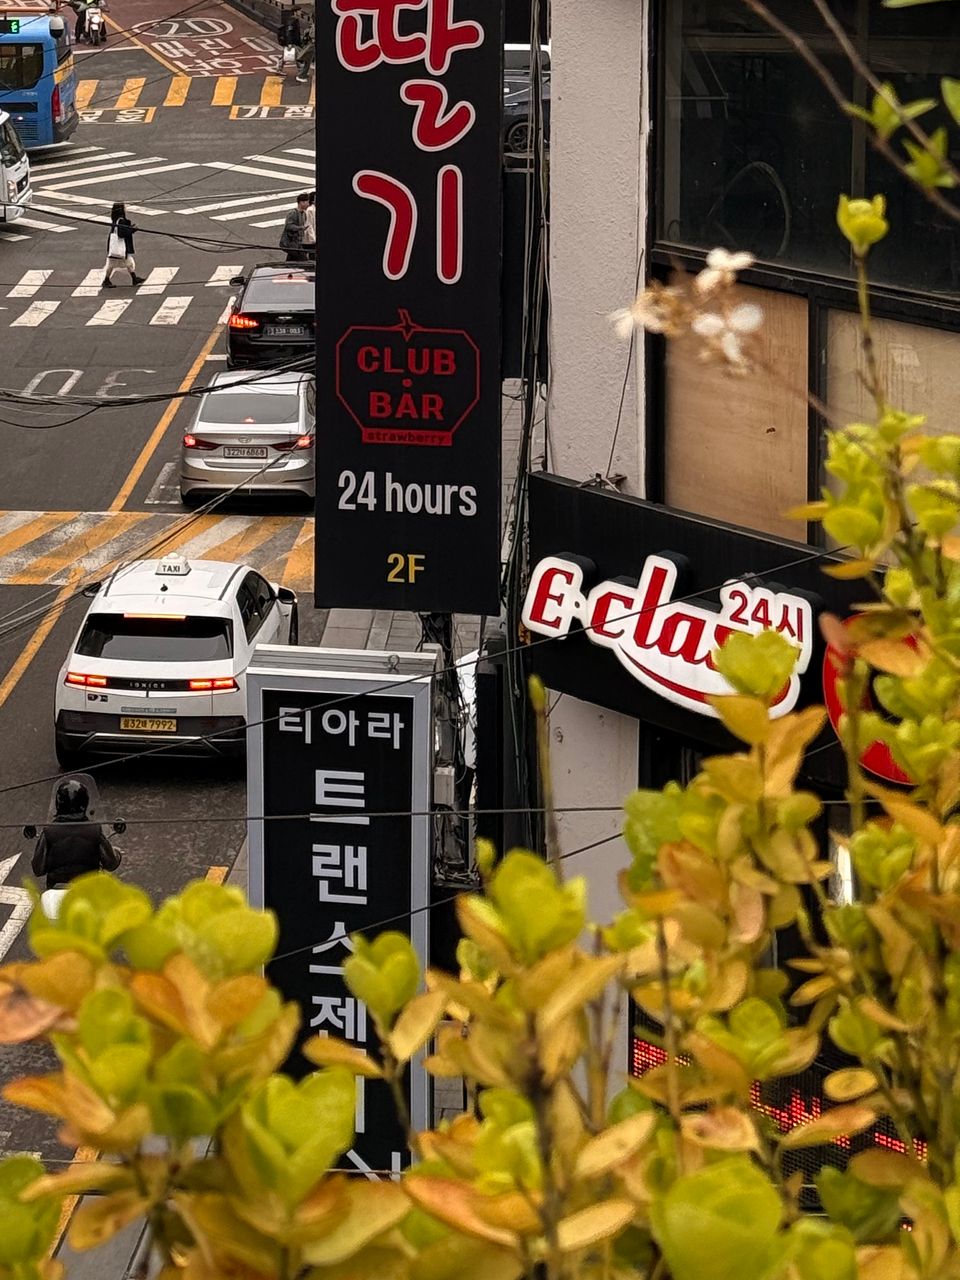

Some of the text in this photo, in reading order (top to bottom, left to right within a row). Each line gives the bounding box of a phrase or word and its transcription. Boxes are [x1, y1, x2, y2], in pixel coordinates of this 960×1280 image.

[356, 345, 457, 376] CLUB
[368, 391, 445, 421] BAR
[337, 470, 478, 518] 24 hours
[161, 565, 181, 573] TAXI
[386, 552, 426, 584] 2F
[728, 589, 804, 643] 24시
[149, 721, 174, 731] 7992
[277, 706, 405, 750] 티아라
